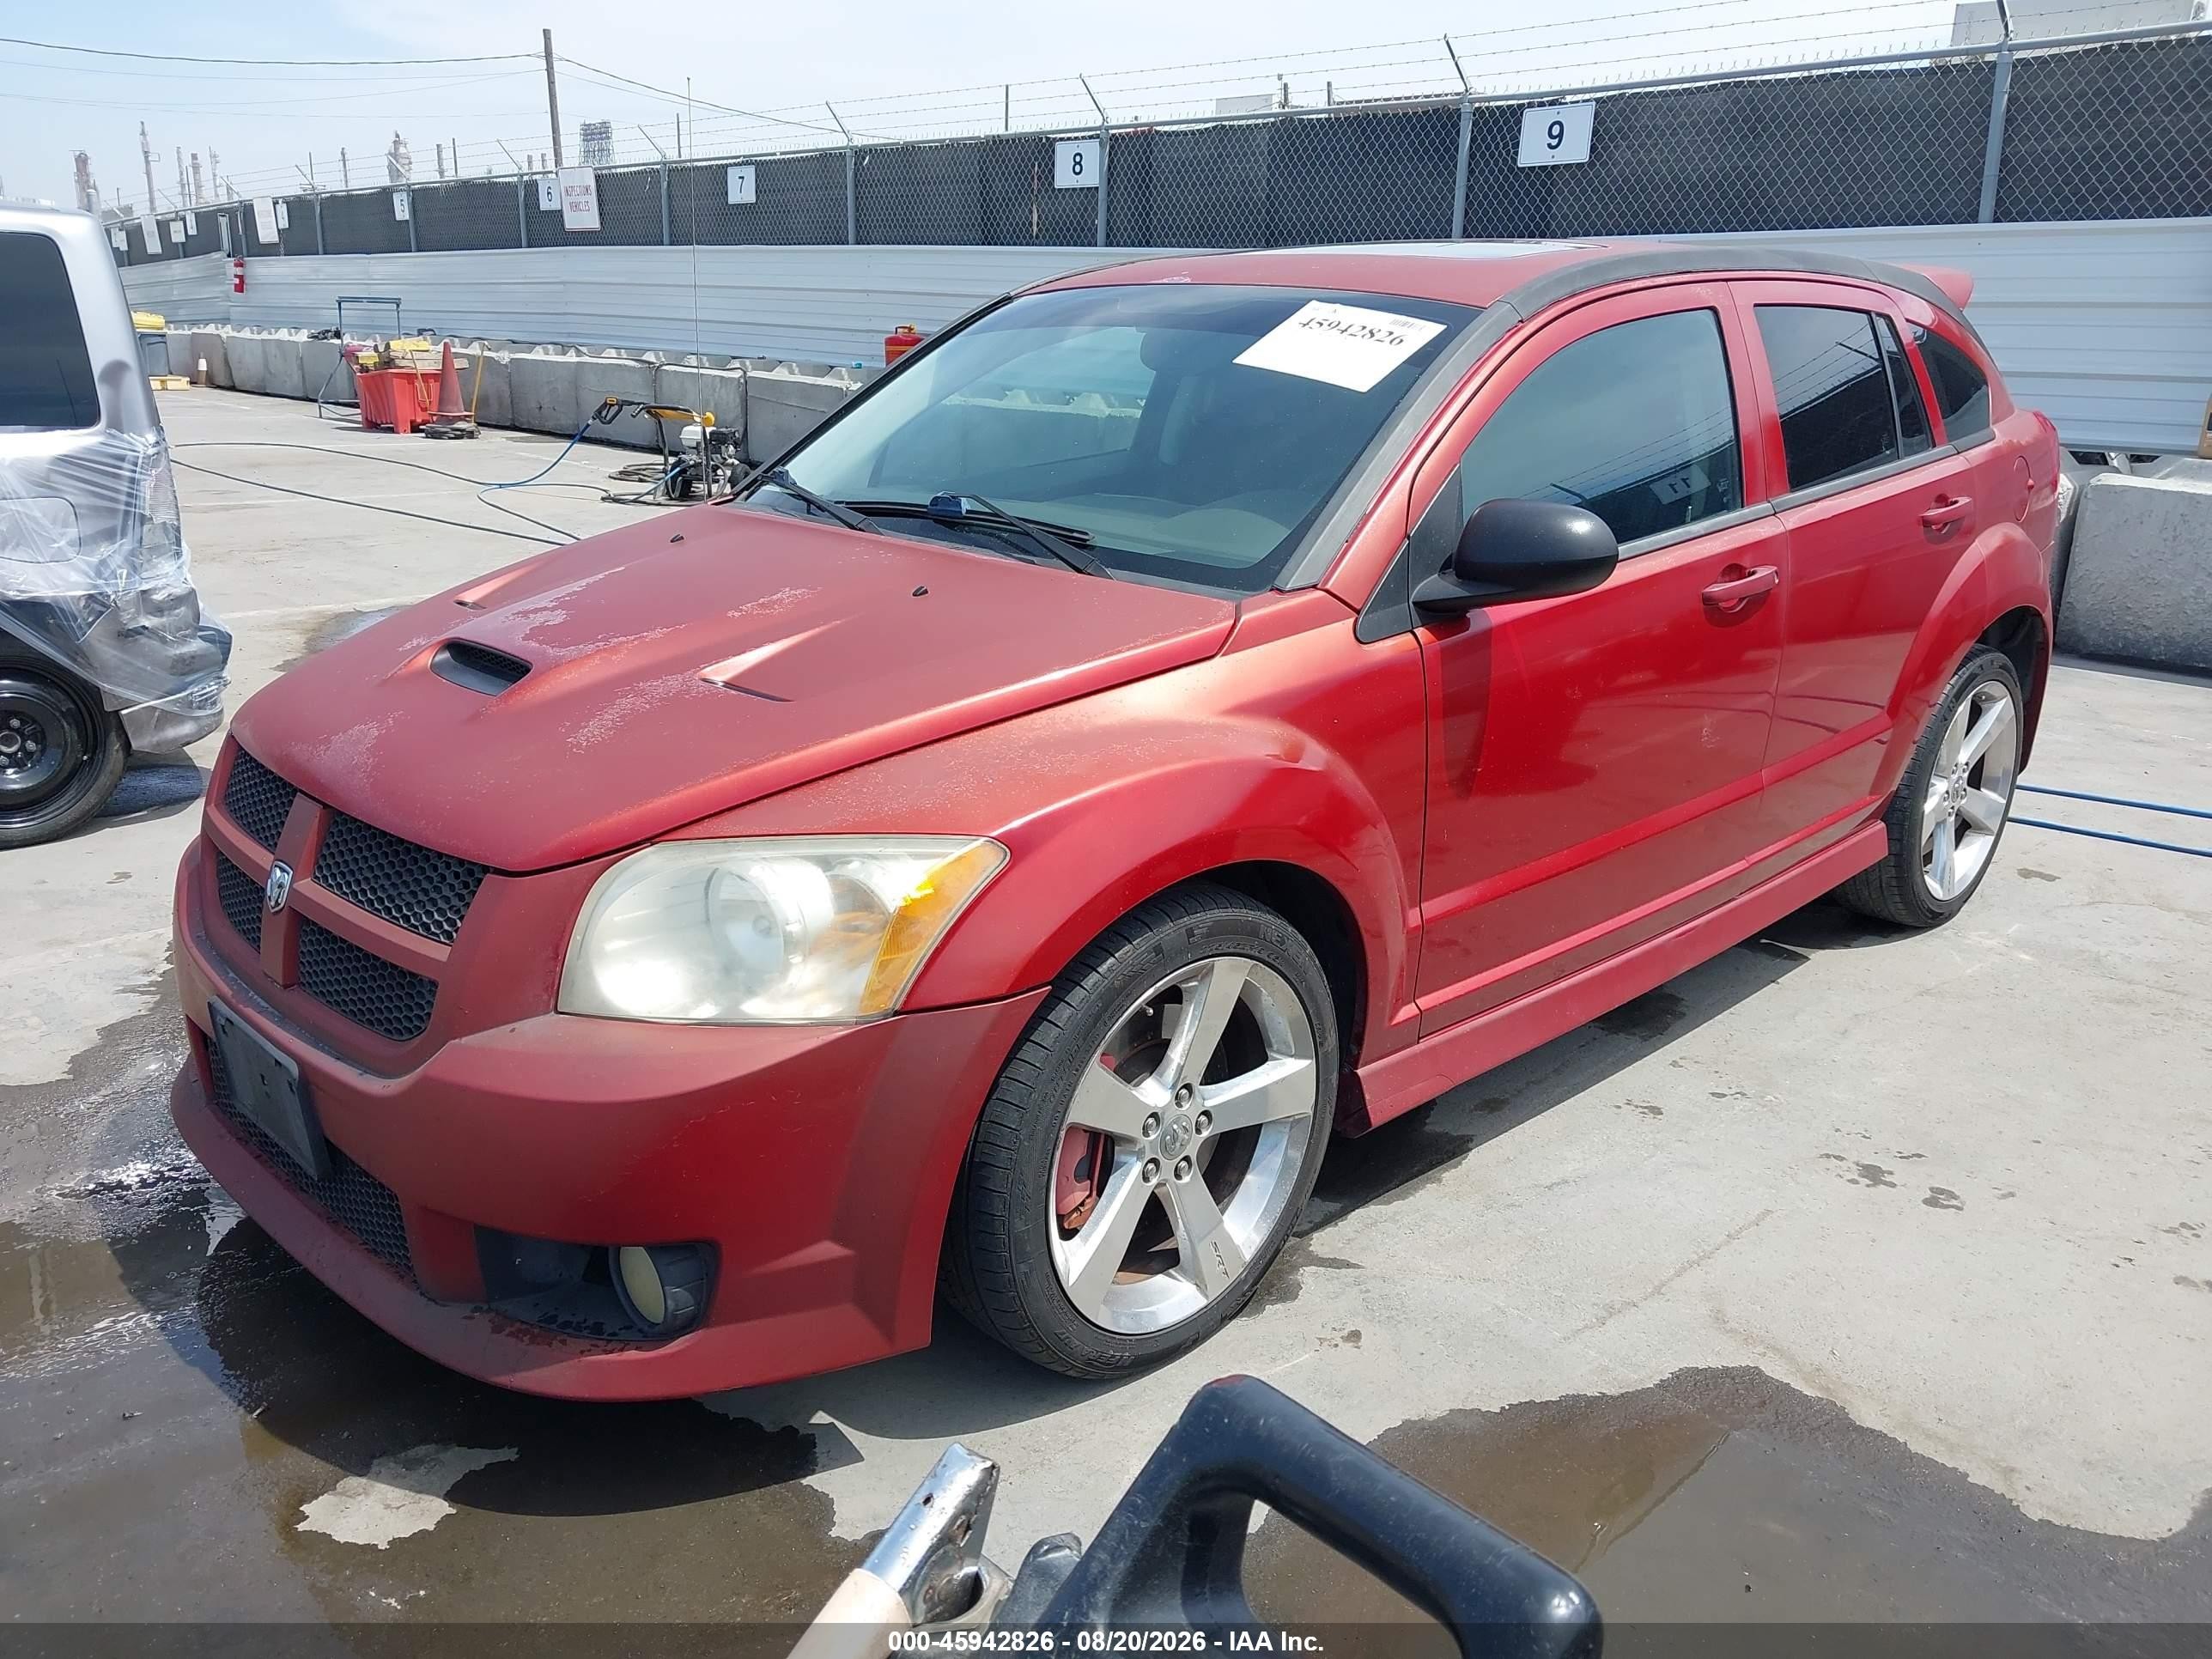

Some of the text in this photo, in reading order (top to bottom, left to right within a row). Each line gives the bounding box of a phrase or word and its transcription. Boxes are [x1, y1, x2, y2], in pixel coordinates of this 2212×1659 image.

[1547, 120, 1565, 150] 9
[1073, 152, 1084, 176] 8
[738, 175, 745, 193] 7
[546, 185, 553, 202] 6
[399, 198, 405, 213] 5
[568, 200, 591, 213] VEHICLES
[1298, 317, 1409, 346] 45942826
